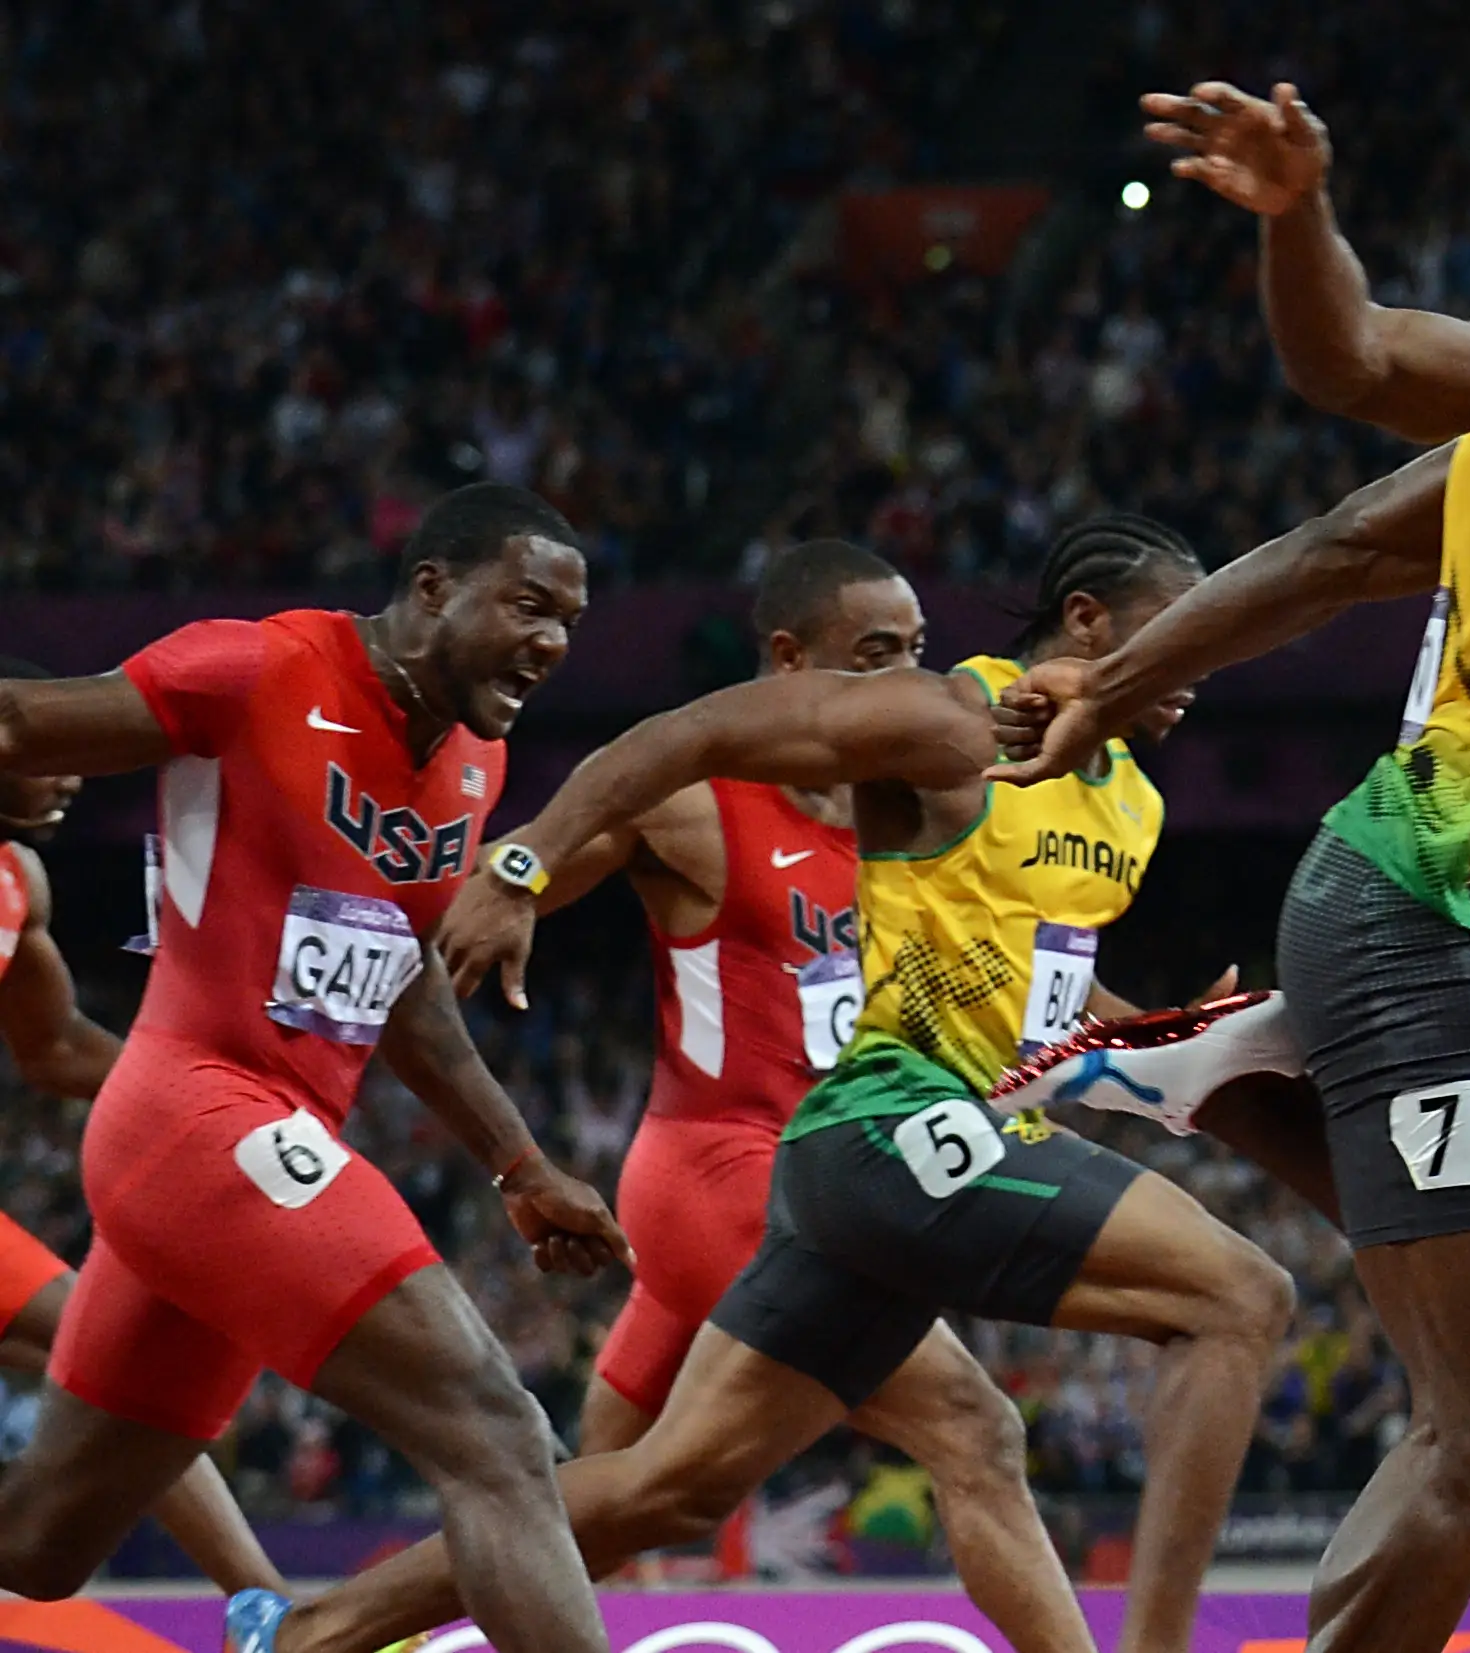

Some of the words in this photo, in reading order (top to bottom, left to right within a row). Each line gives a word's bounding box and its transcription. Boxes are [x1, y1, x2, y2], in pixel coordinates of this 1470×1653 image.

[324, 760, 473, 885] USA
[272, 1127, 325, 1185] 6
[925, 1112, 972, 1179] 5
[1419, 1094, 1460, 1177] 7
